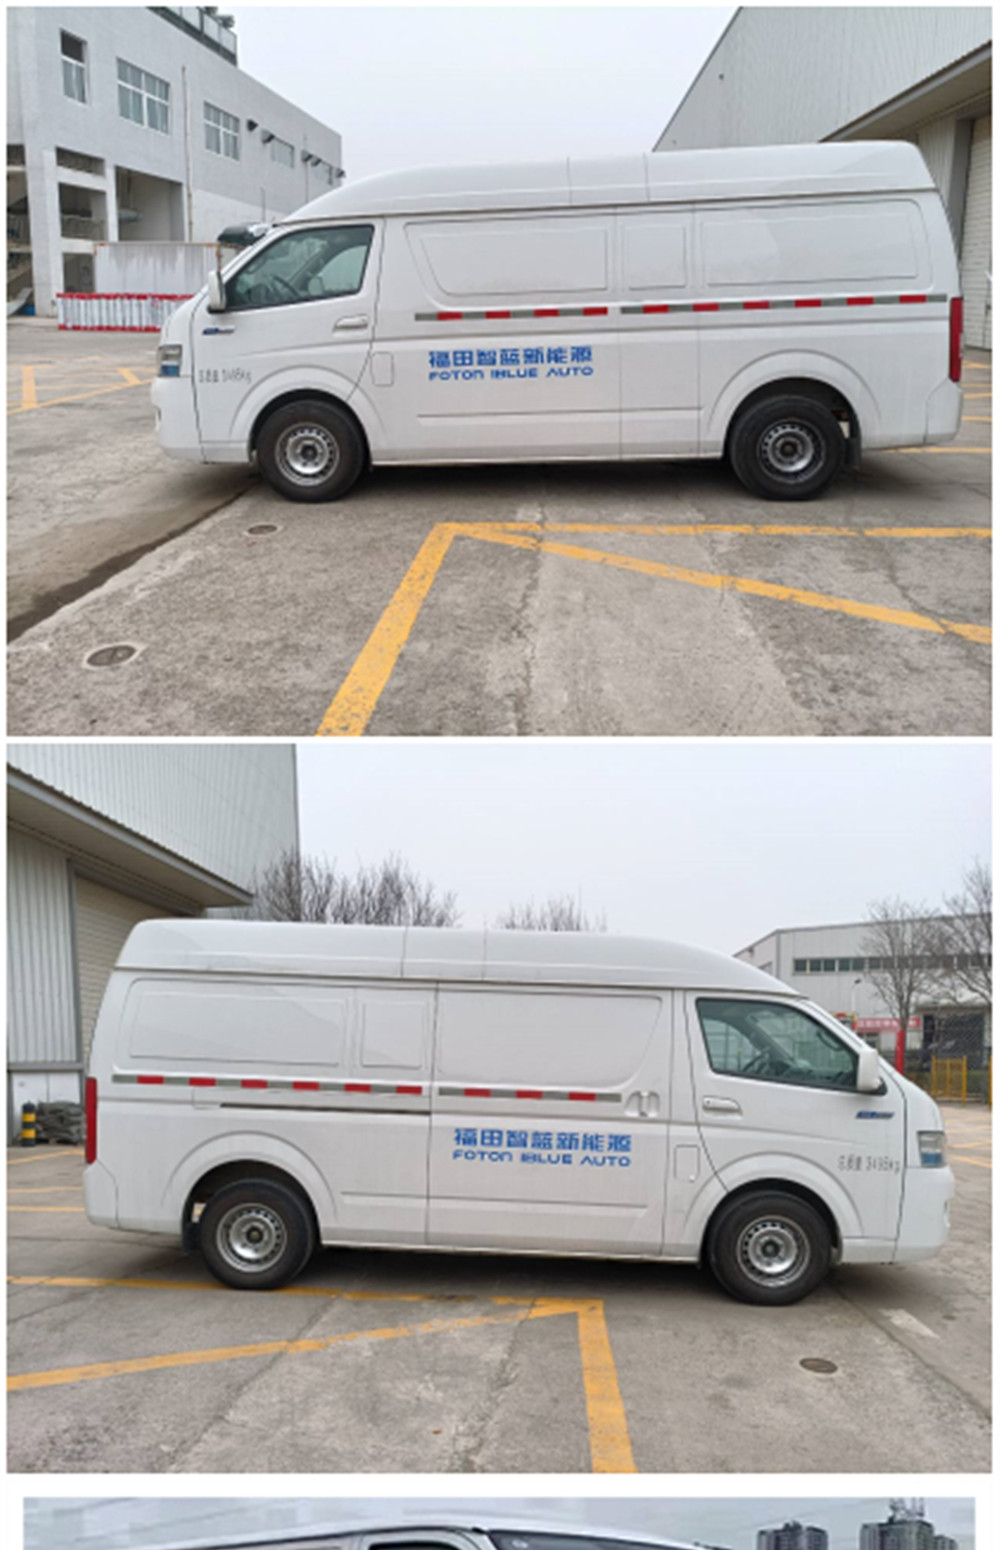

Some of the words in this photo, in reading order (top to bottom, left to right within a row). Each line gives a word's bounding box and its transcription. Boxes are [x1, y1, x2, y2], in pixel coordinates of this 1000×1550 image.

[428, 345, 593, 369] 福田智蓝新能源
[545, 366, 594, 378] AUTO
[454, 1127, 632, 1153] 福田智蓝新能源
[579, 1155, 632, 1168] AUTO
